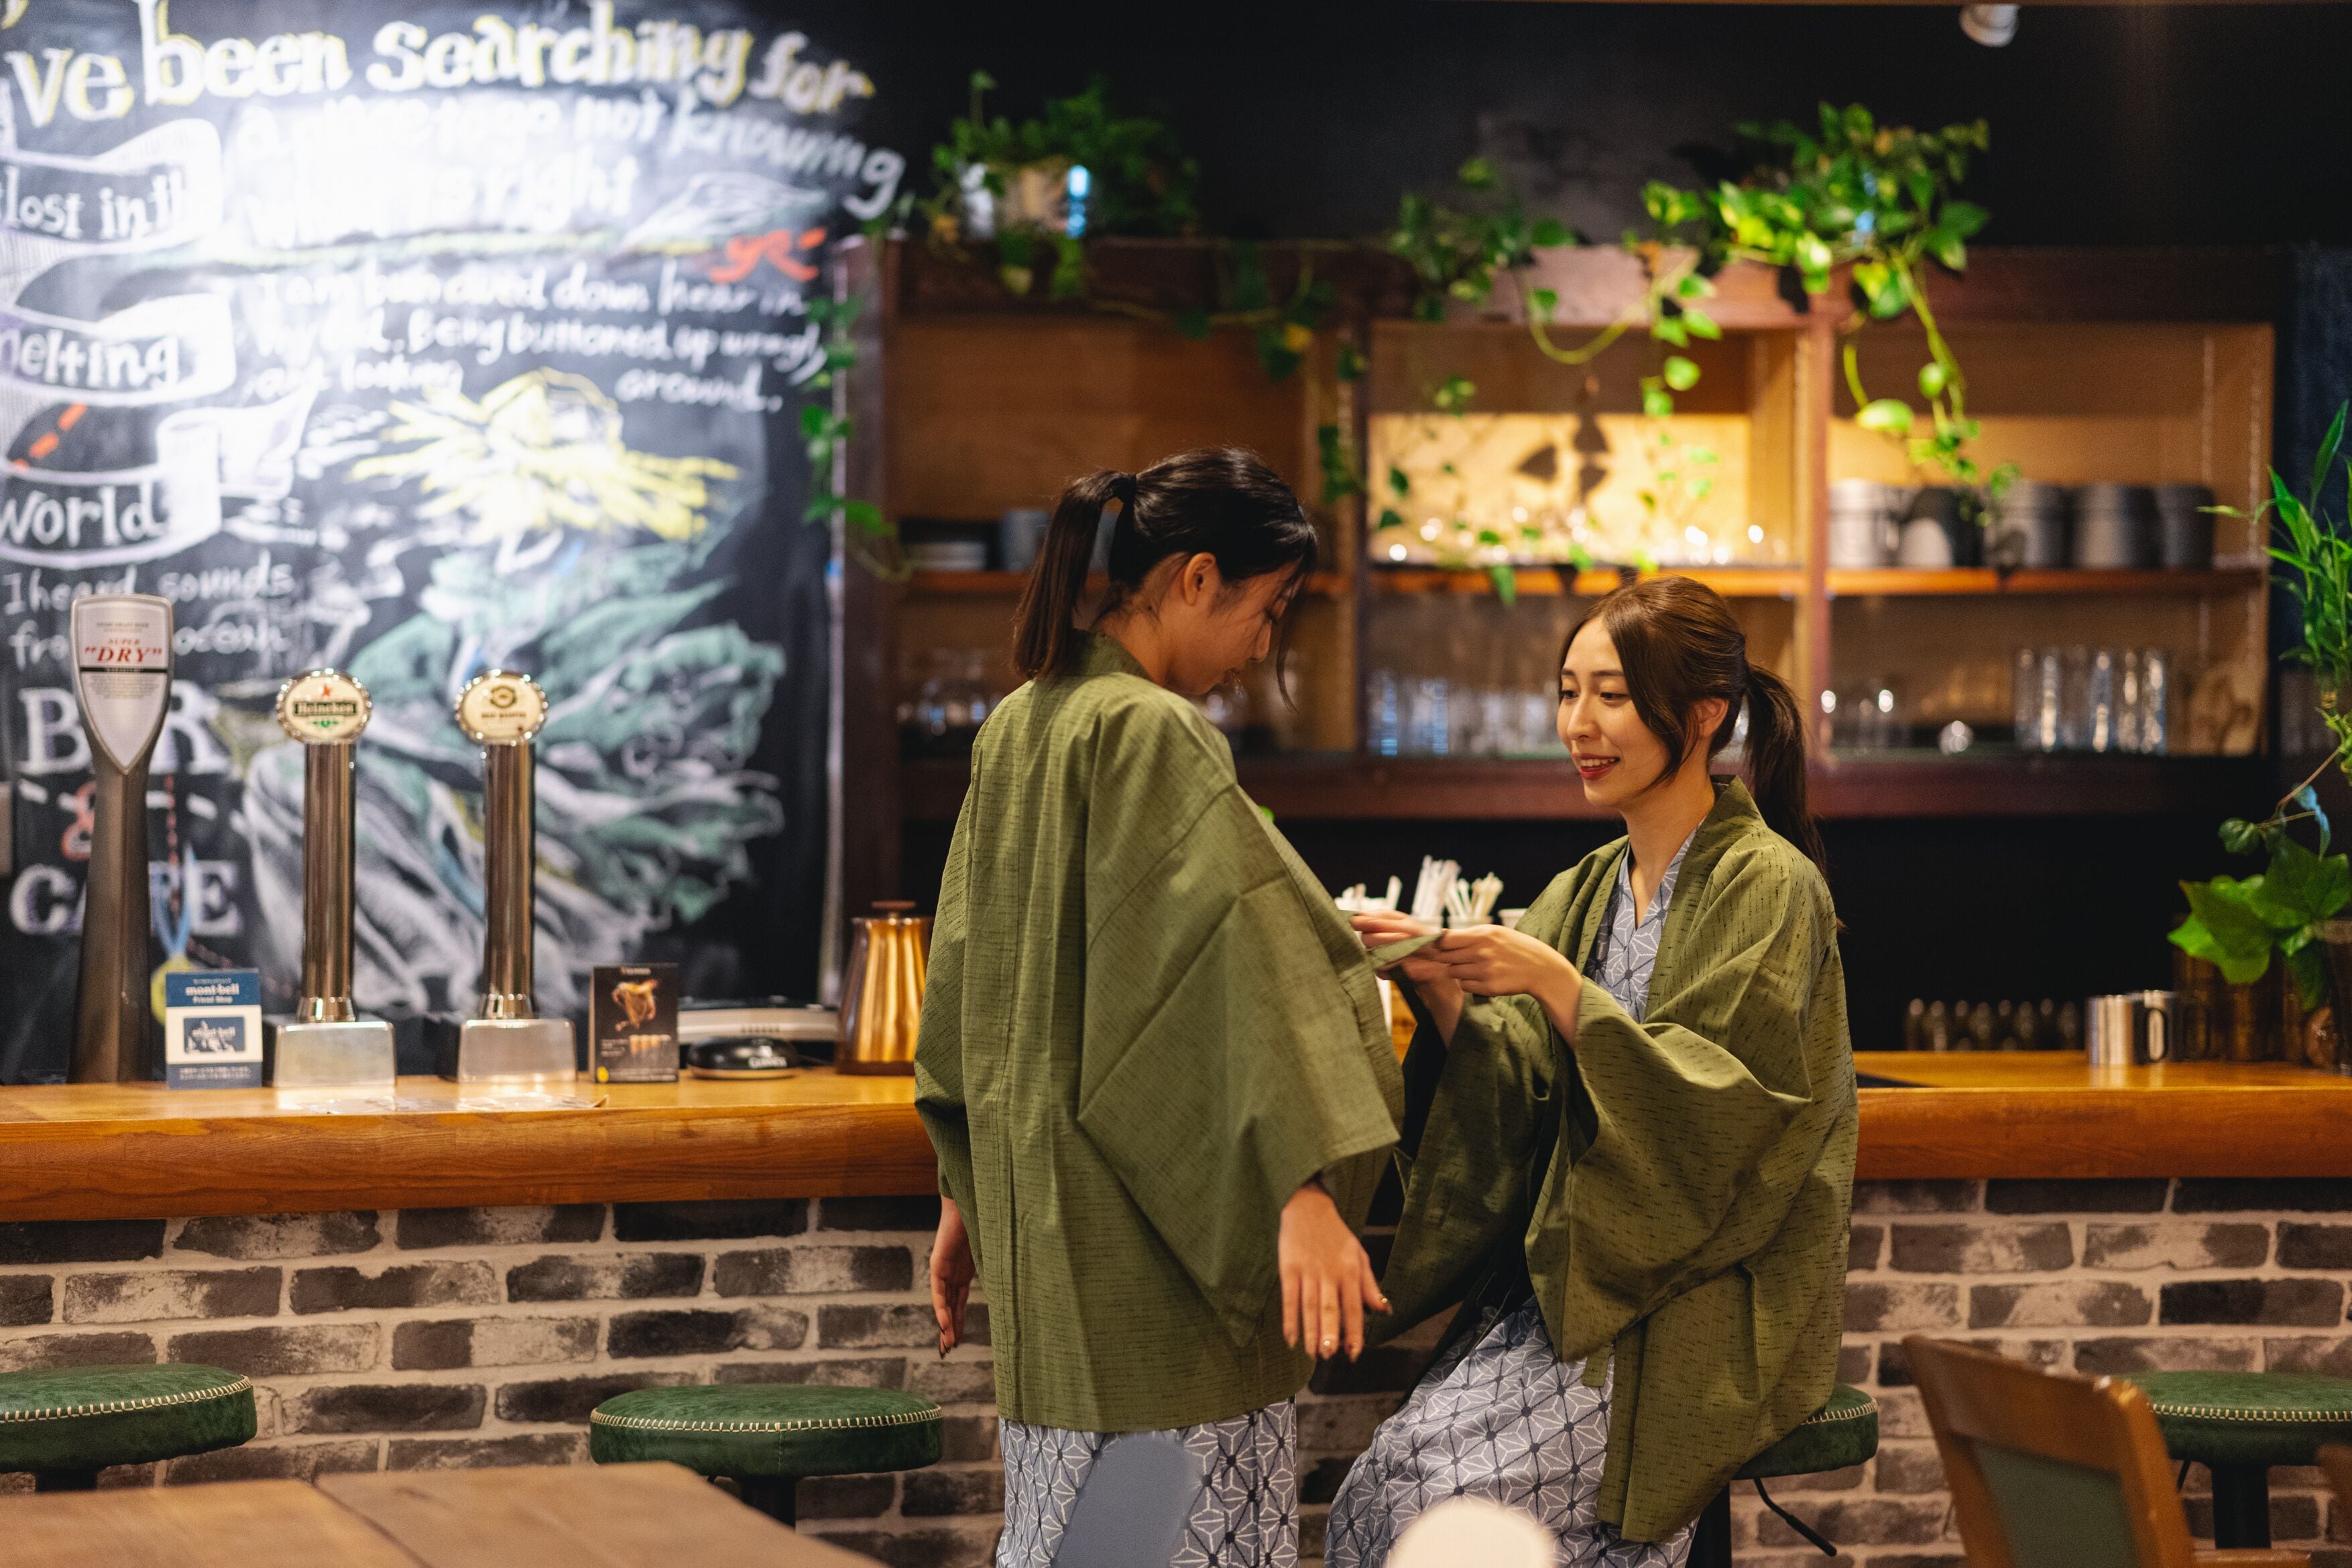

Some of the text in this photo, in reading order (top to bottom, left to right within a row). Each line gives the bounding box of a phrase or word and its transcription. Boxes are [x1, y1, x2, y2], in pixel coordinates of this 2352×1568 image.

[139, 0, 354, 106] been
[365, 0, 754, 106] searching
[748, 31, 876, 113] for
[481, 142, 641, 233] right
[575, 88, 666, 143] not
[670, 87, 906, 221] knowing
[5, 165, 82, 239] lost
[99, 186, 156, 241] in
[158, 551, 296, 605] sounds
[9, 618, 68, 670] fro
[16, 678, 236, 775] BR
[297, 701, 355, 715] Heineken
[9, 859, 243, 937] CFE
